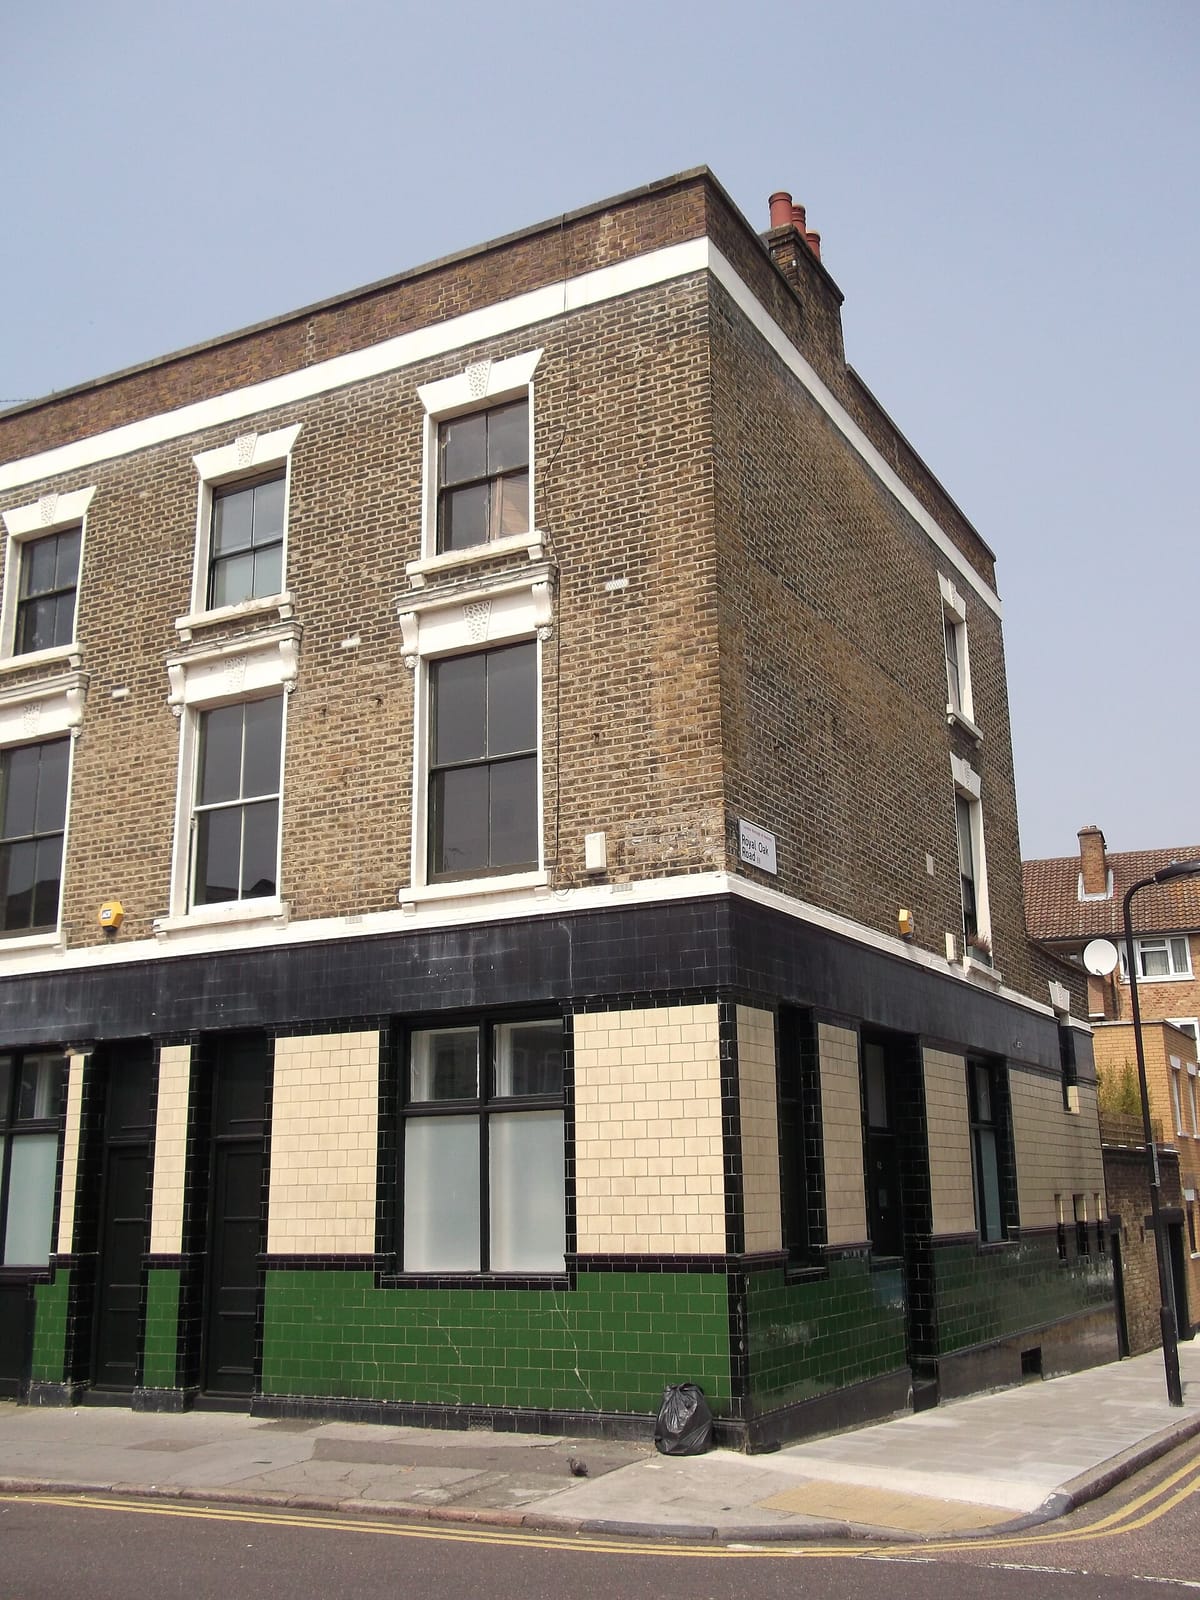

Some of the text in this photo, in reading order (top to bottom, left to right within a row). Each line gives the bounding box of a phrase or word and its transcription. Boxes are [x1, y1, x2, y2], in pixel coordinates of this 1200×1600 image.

[742, 834, 769, 856] Royal Oak
[742, 846, 755, 861] Road
